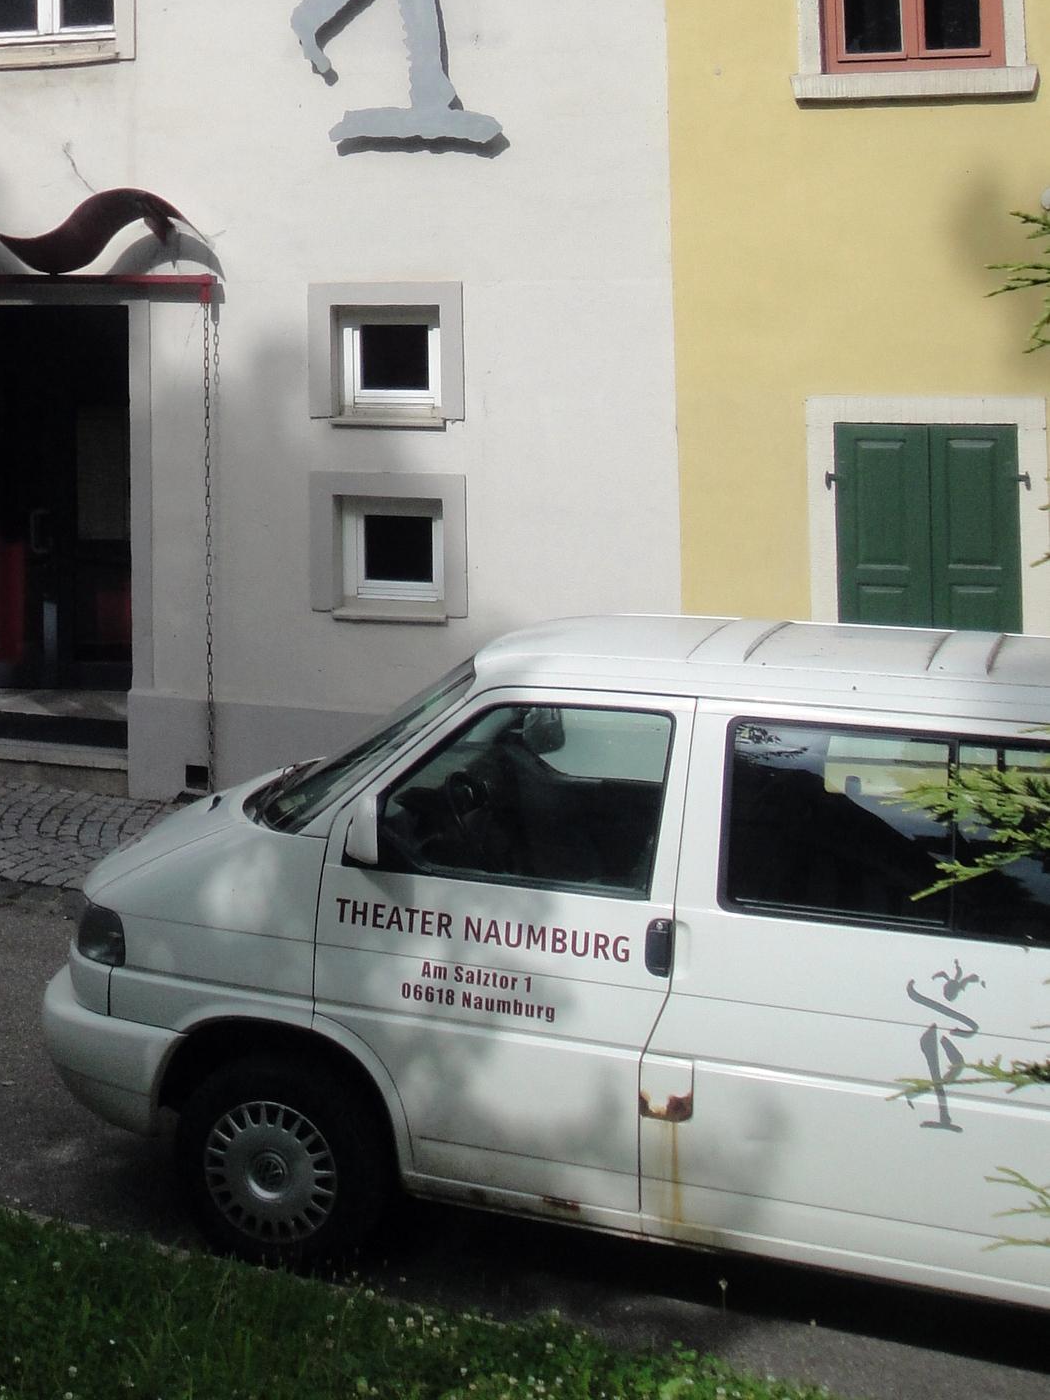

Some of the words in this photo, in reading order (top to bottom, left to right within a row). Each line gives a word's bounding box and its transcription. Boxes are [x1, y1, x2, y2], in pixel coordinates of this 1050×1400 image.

[336, 897, 453, 939] THEATER
[464, 915, 631, 963] NAUMBURG
[421, 961, 448, 980] Am
[453, 965, 518, 991] Salztor
[524, 976, 532, 993] 1
[401, 982, 455, 1006] 06618
[461, 991, 556, 1023] Naumburg
